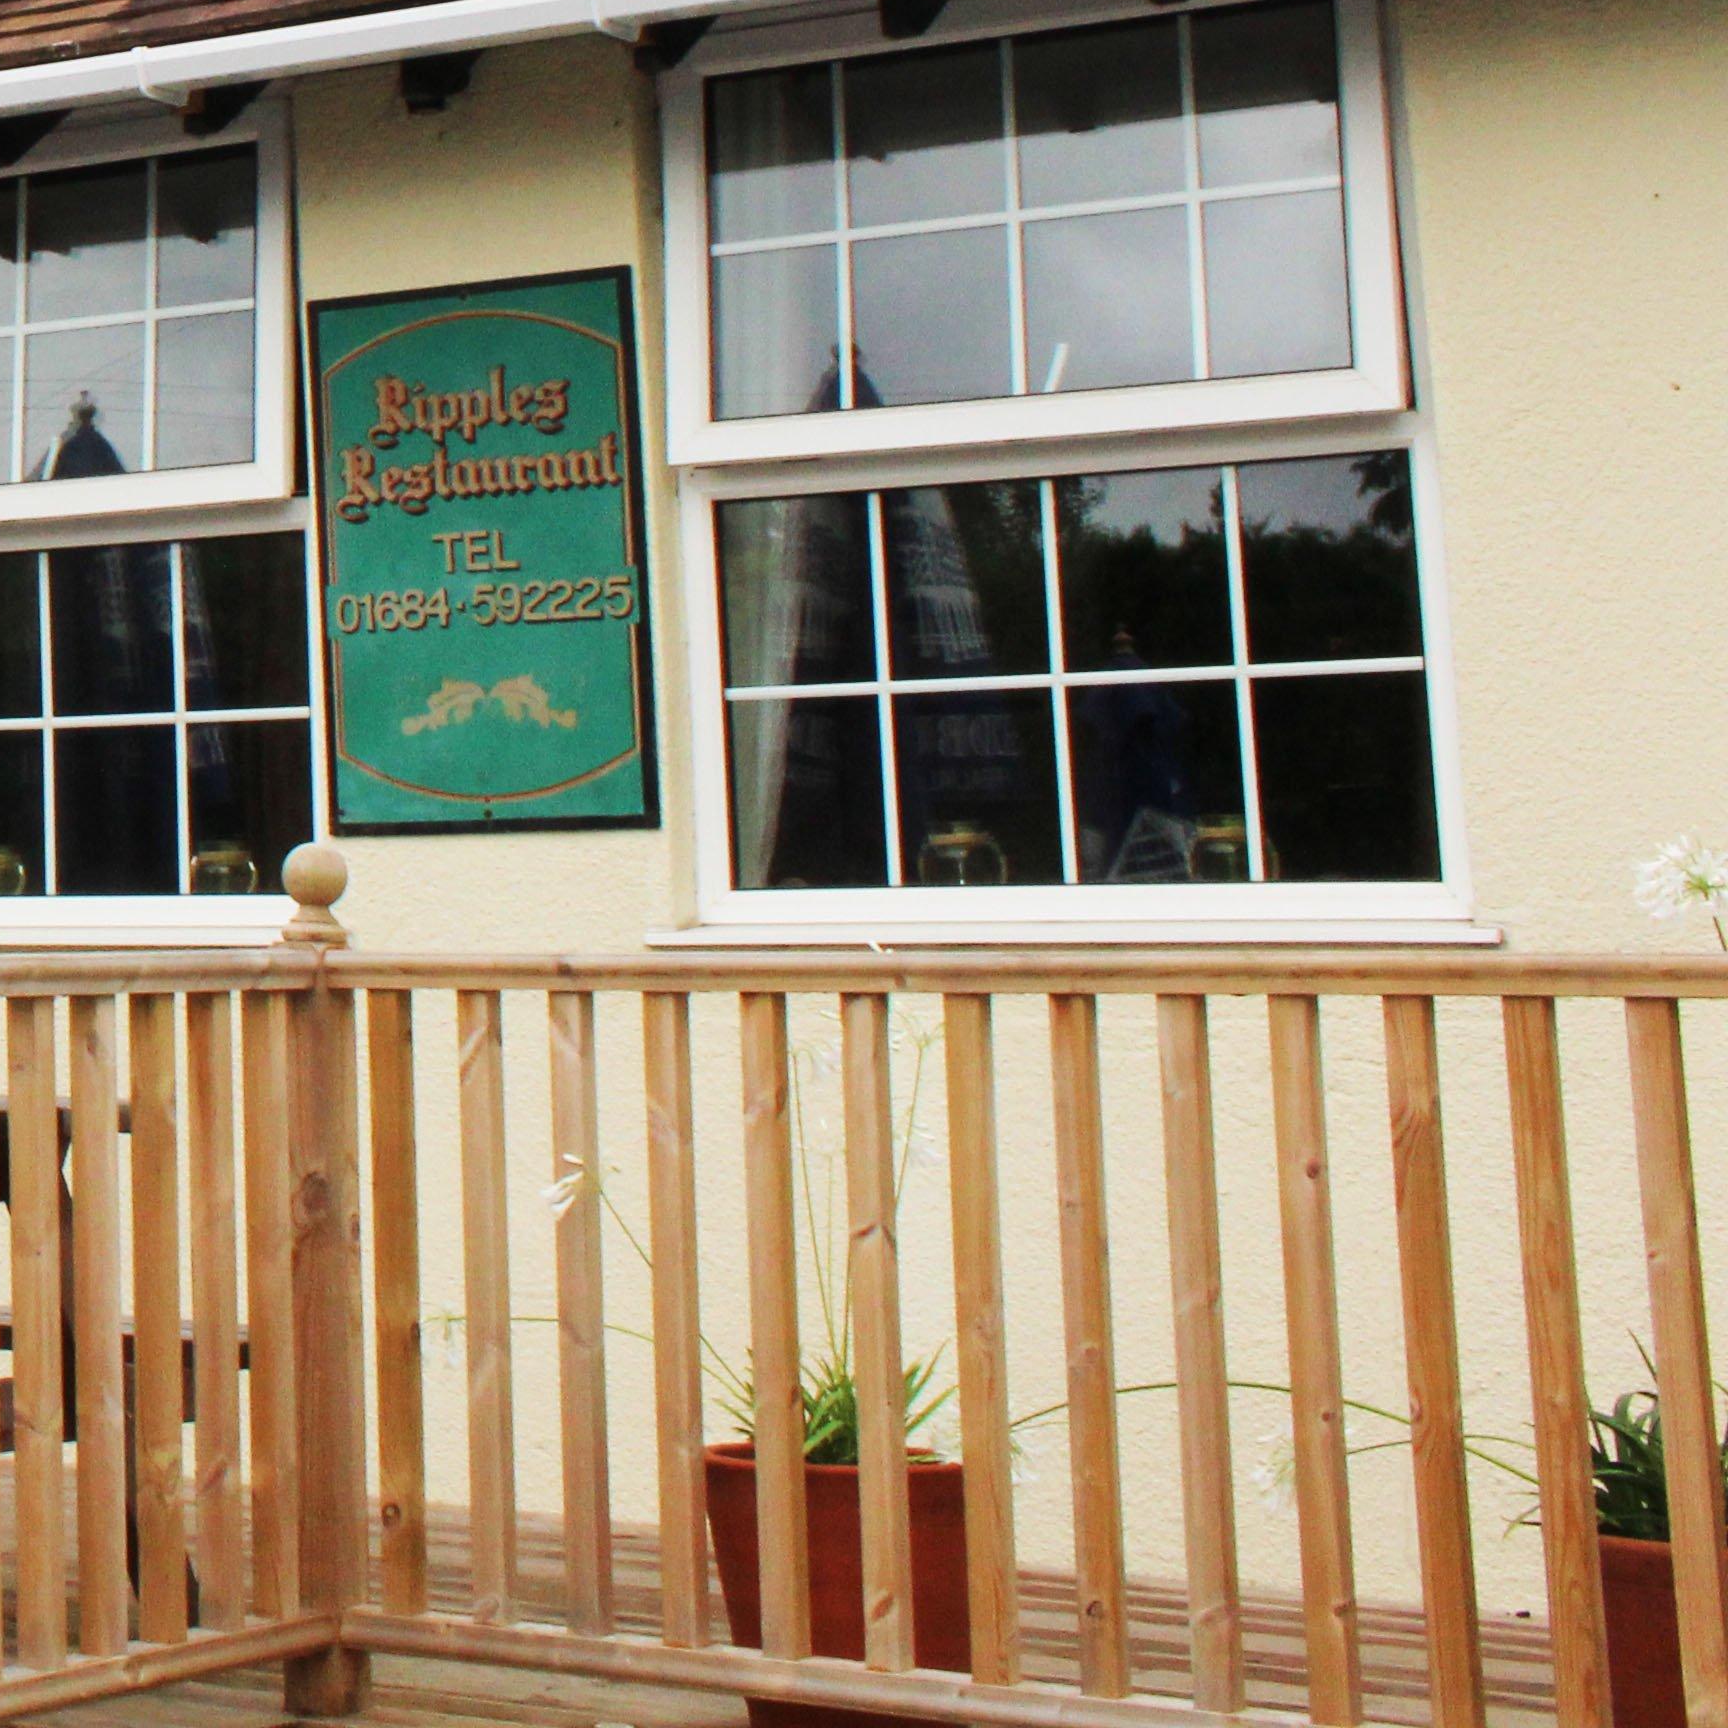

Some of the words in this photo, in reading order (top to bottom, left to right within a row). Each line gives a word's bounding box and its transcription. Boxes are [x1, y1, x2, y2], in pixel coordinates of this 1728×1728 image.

[367, 364, 570, 447] Ripples
[337, 432, 623, 522] Restaurant
[432, 529, 521, 573] TEL
